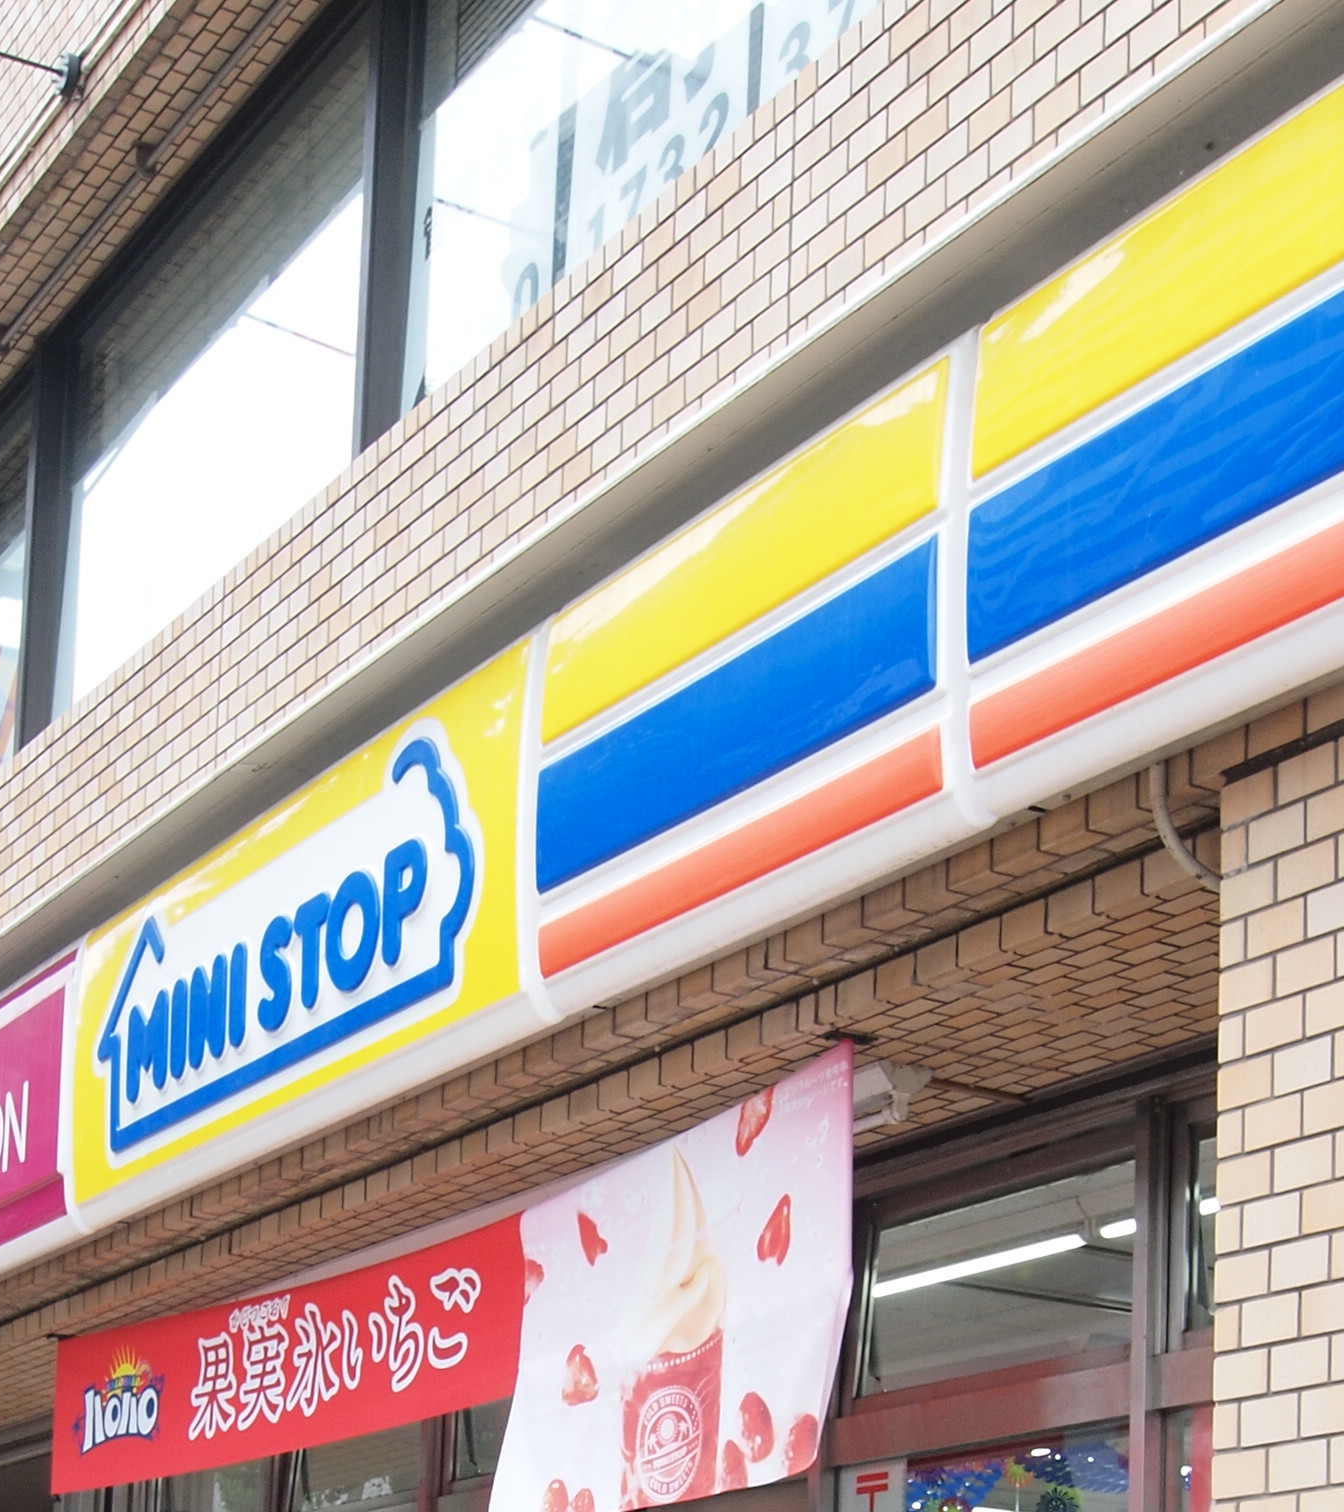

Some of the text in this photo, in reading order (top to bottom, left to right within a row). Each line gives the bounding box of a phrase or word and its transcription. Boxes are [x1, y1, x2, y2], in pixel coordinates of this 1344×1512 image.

[126, 837, 428, 1104] MINI STOP
[188, 1268, 482, 1441] 果実氷いちご
